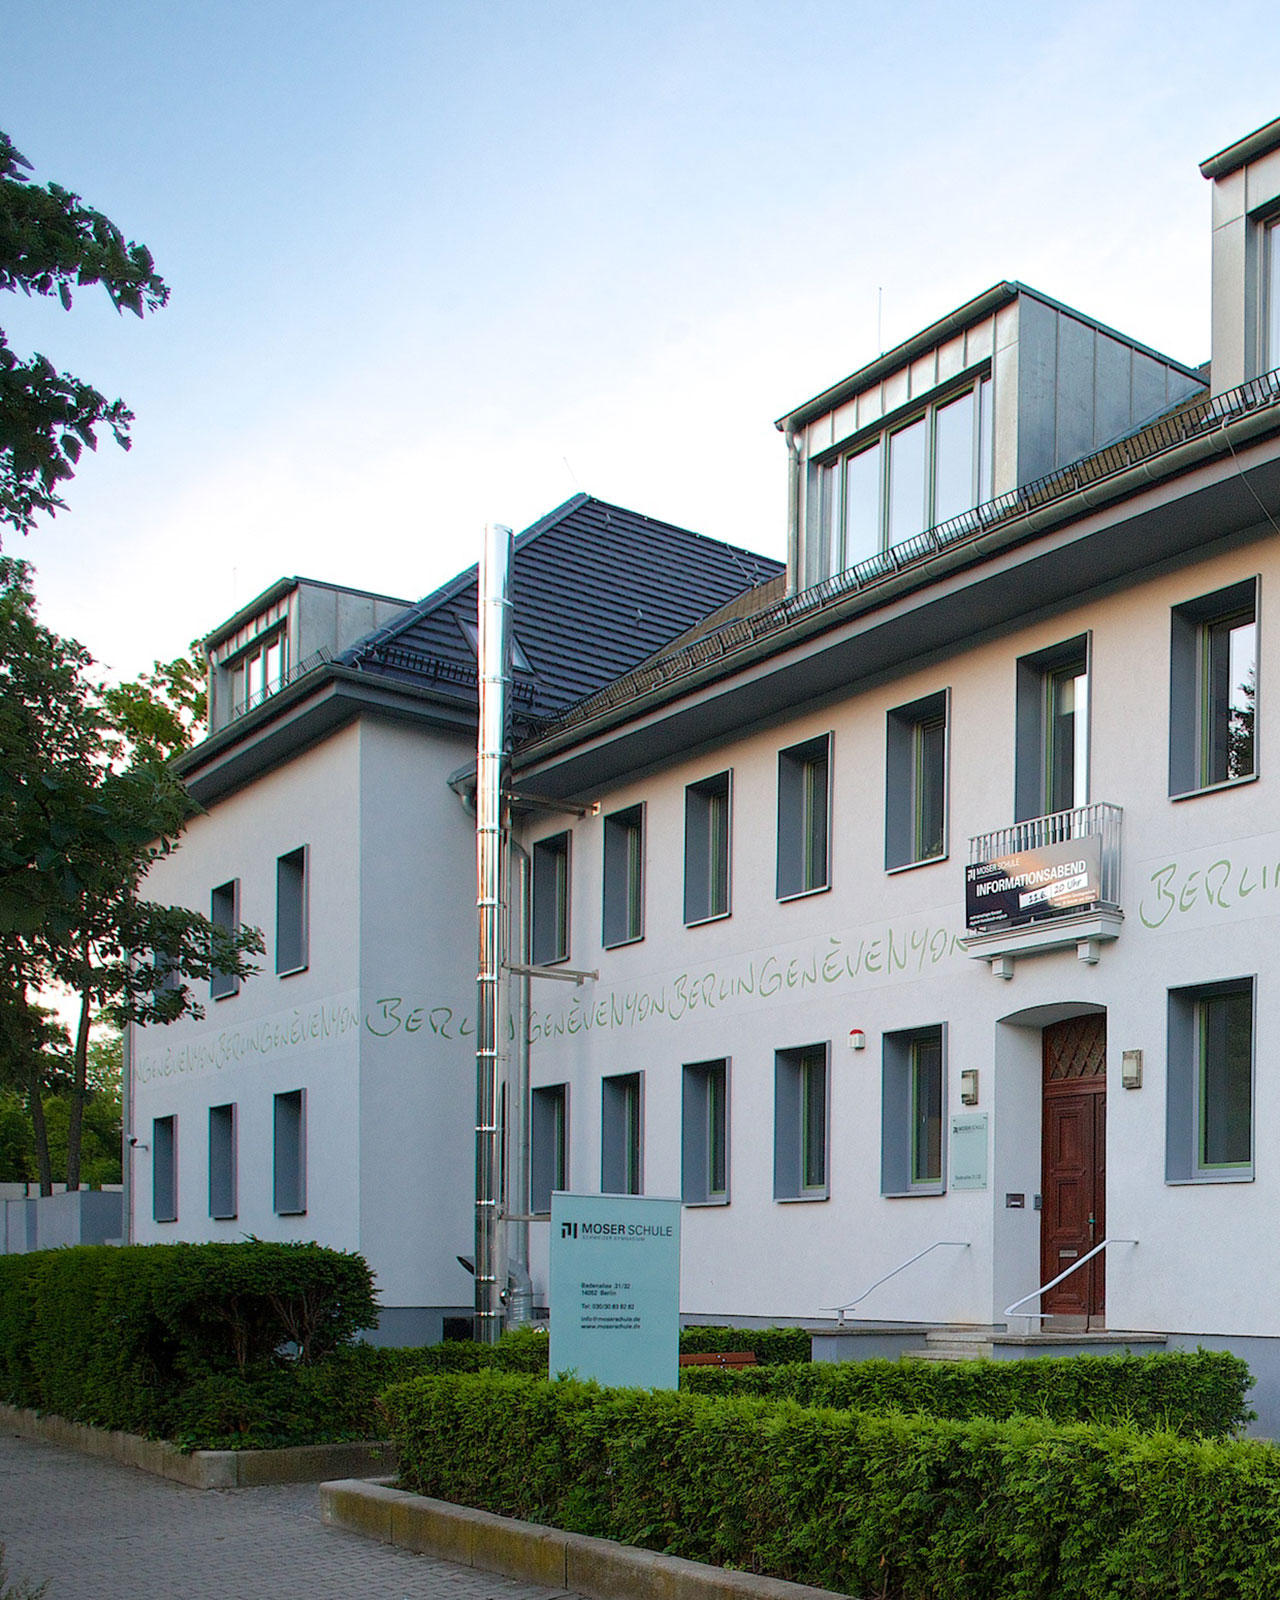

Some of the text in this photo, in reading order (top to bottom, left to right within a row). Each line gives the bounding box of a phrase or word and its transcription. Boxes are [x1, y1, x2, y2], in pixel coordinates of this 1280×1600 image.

[976, 863, 997, 875] MOSER
[976, 860, 1086, 897] INFORMATIONSABEND
[582, 1222, 673, 1237] MOSER SCHULE
